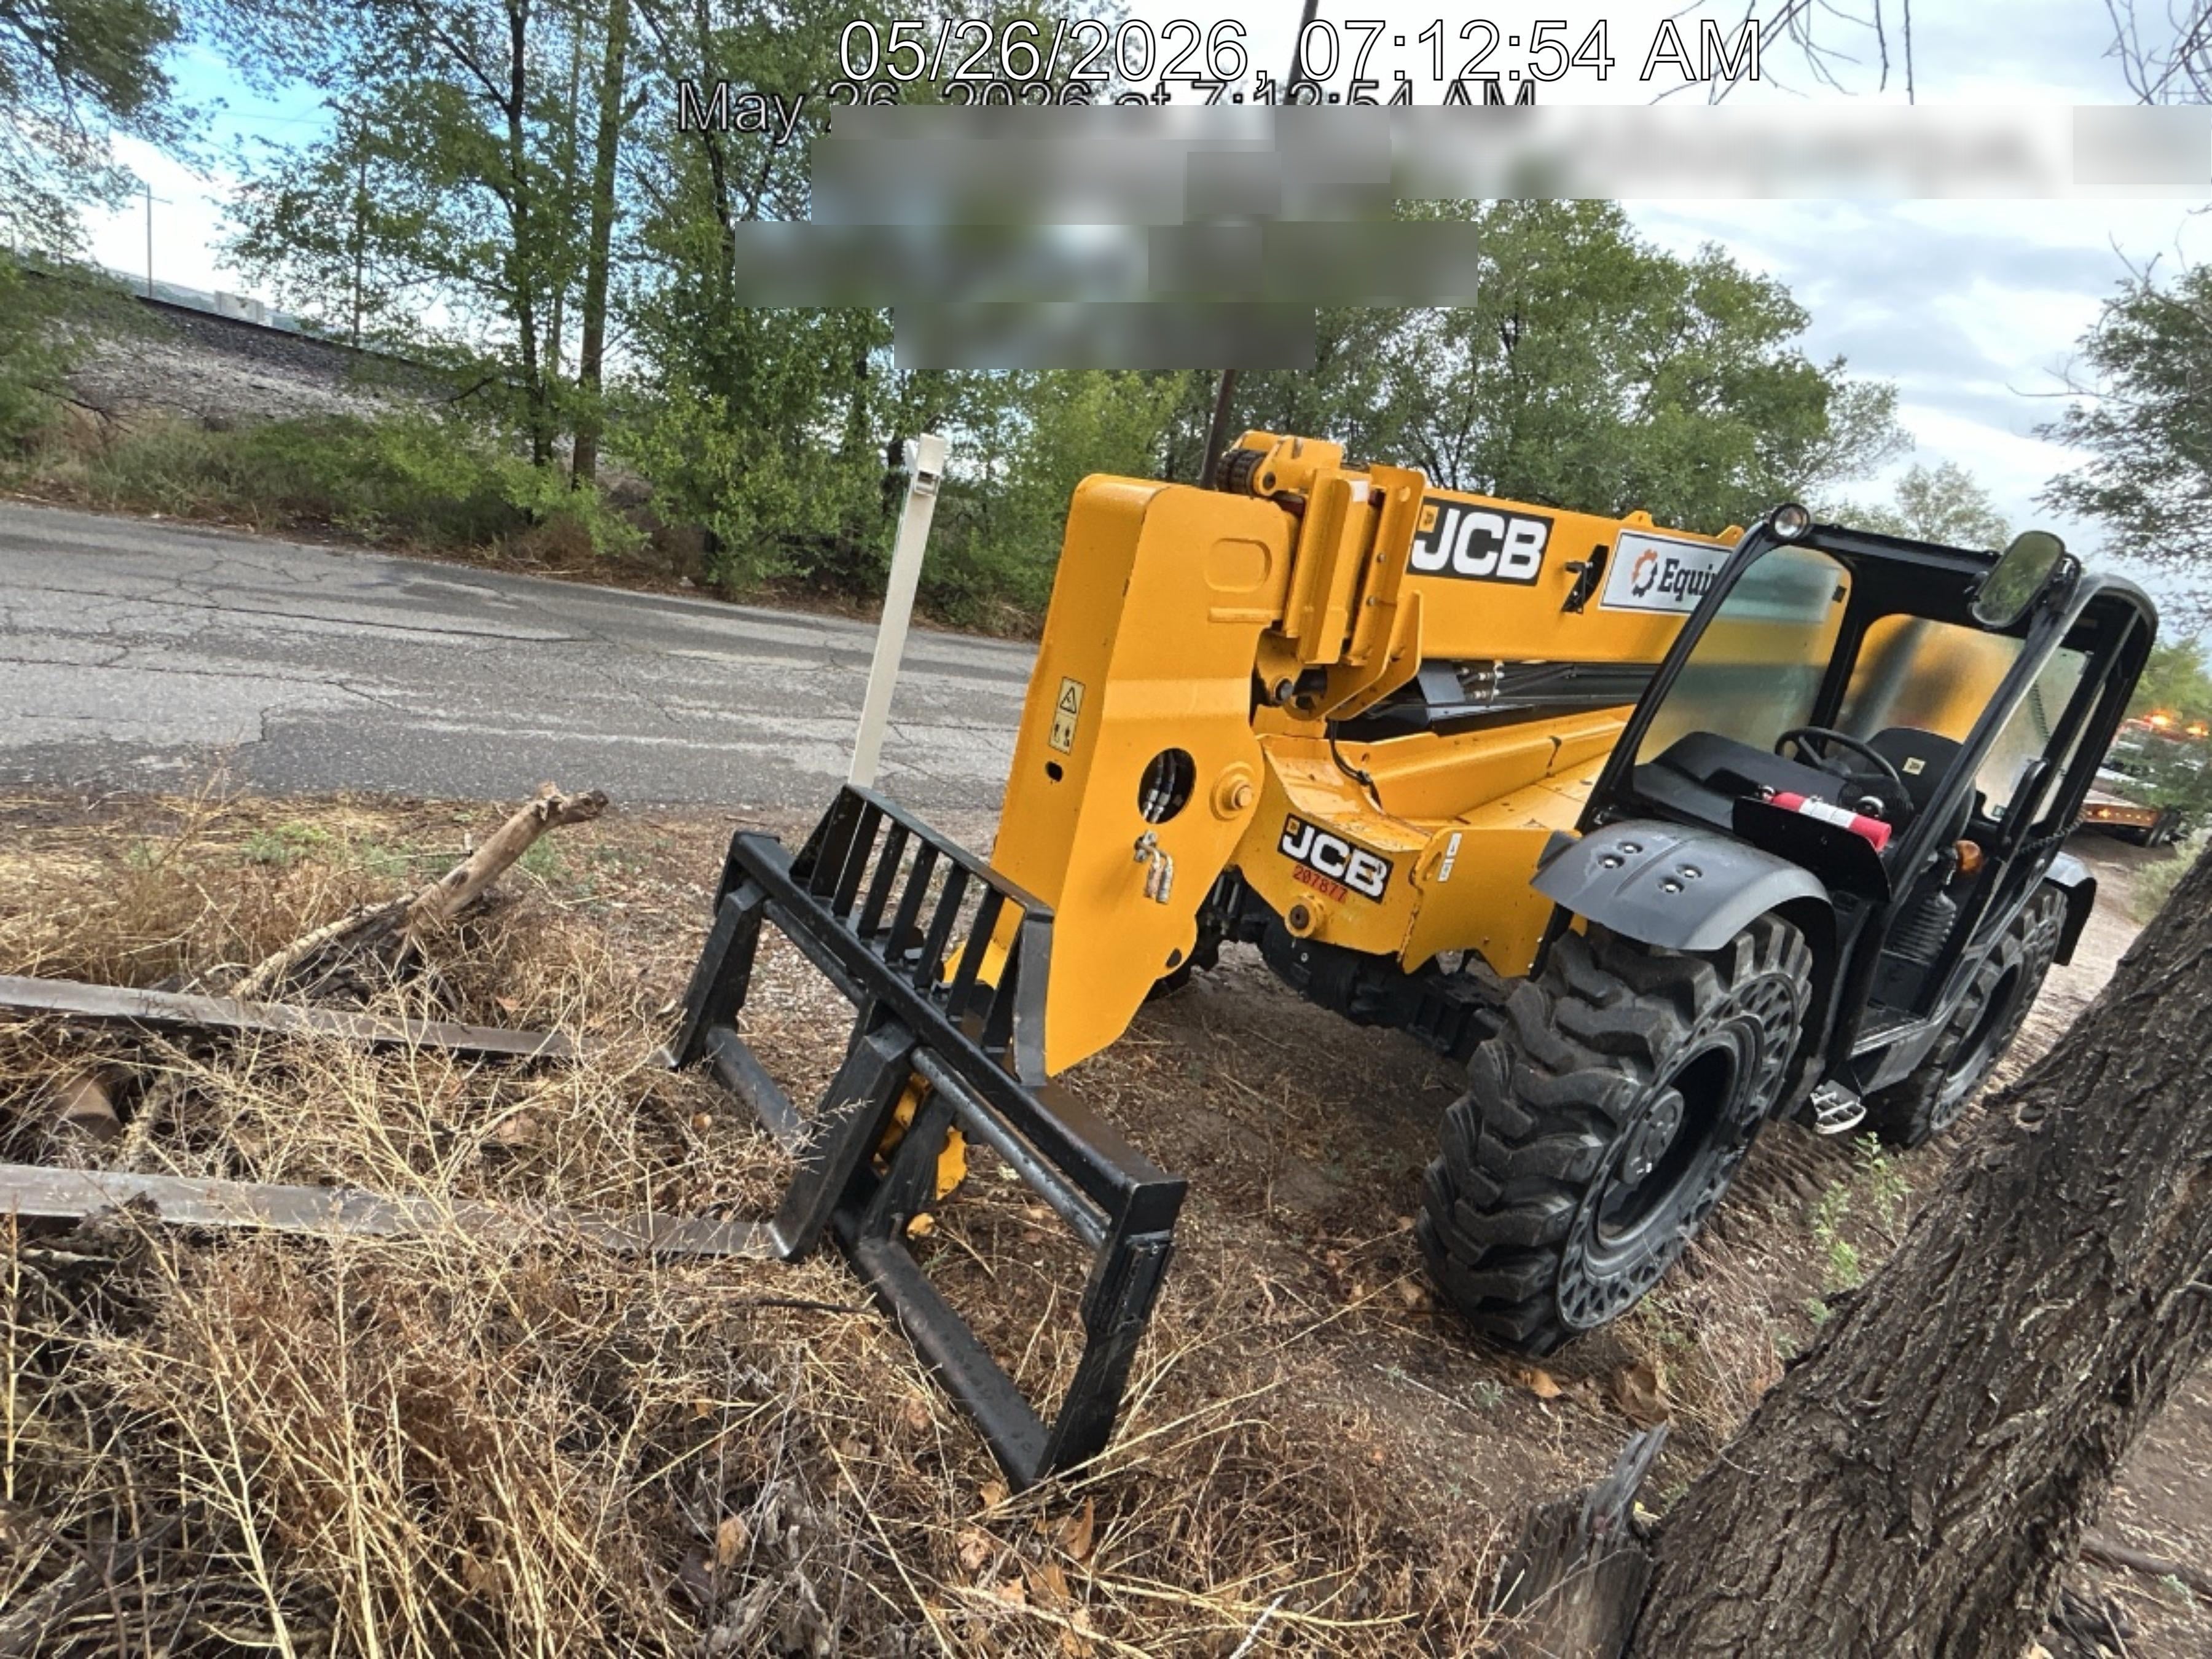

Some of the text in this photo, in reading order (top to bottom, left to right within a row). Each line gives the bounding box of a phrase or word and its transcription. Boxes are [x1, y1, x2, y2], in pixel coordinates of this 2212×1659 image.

[1411, 508, 1547, 579] JCB
[1657, 558, 1719, 602] Equi
[1282, 825, 1387, 898] JCB
